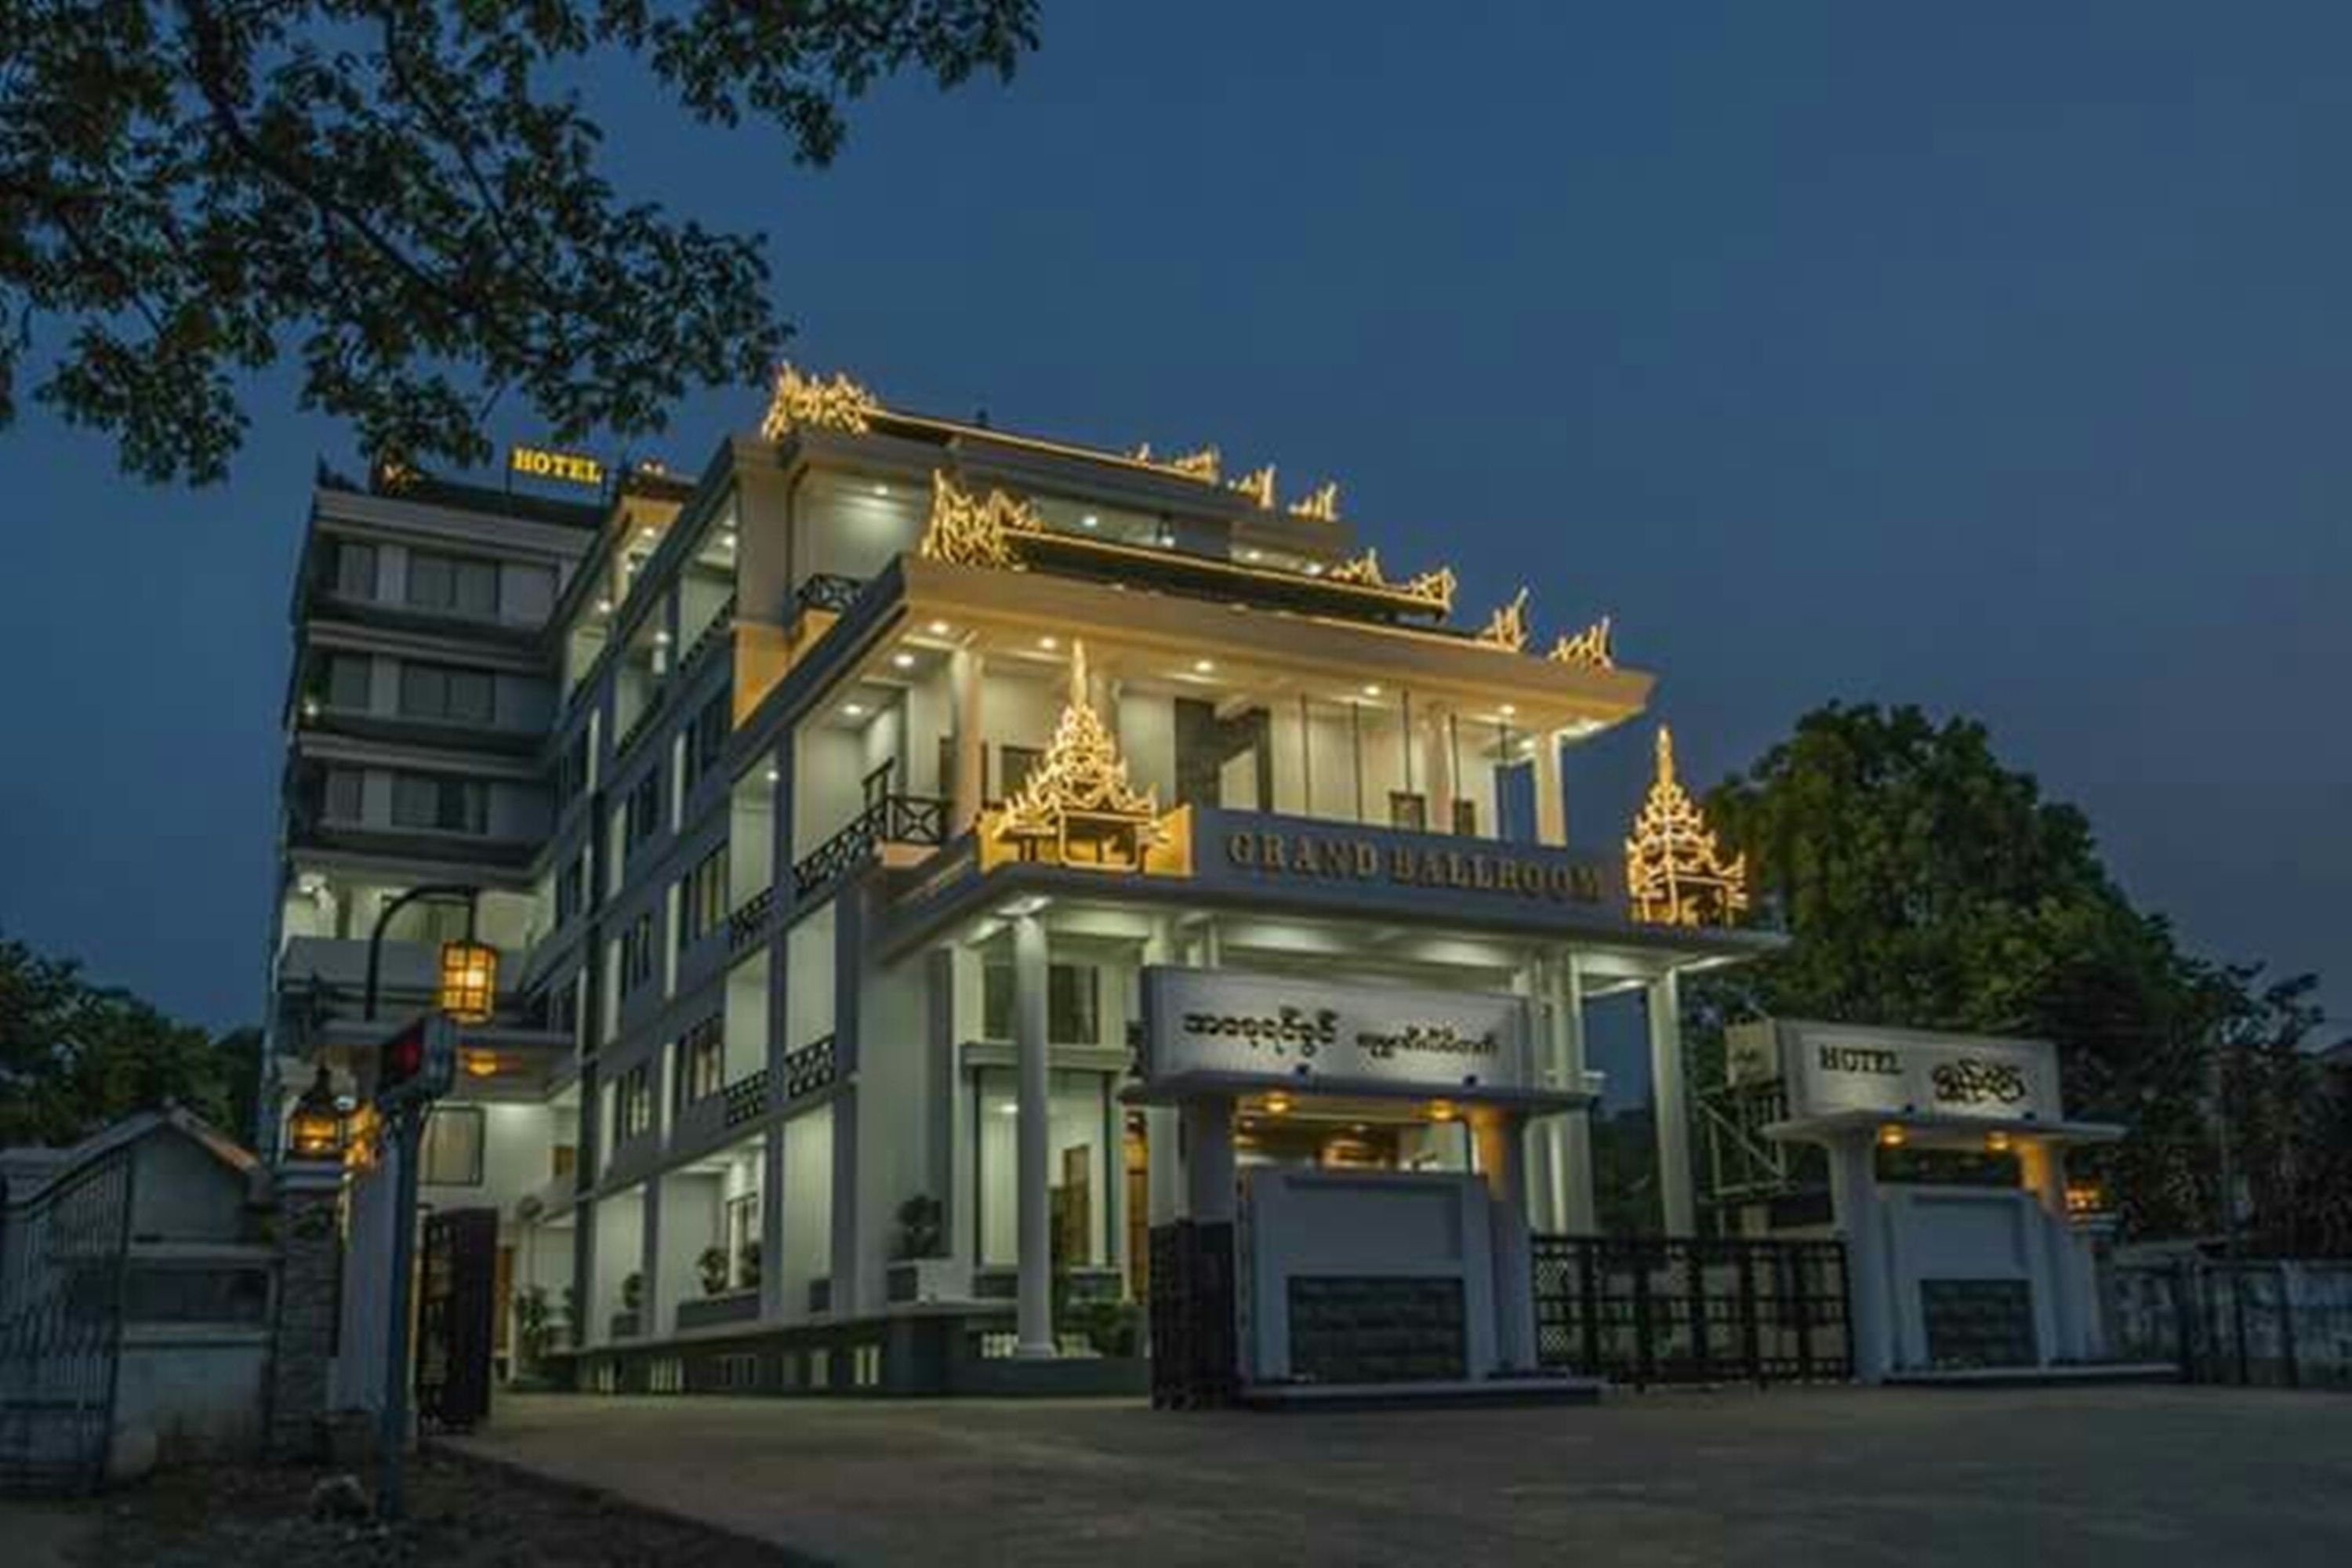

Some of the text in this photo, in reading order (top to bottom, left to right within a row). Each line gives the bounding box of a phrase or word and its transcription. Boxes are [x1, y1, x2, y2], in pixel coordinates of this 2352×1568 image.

[513, 445, 602, 485] HOTEL
[1228, 832, 1602, 903] GRAND BALLROOM
[1819, 1045, 1904, 1075] HOTEL
